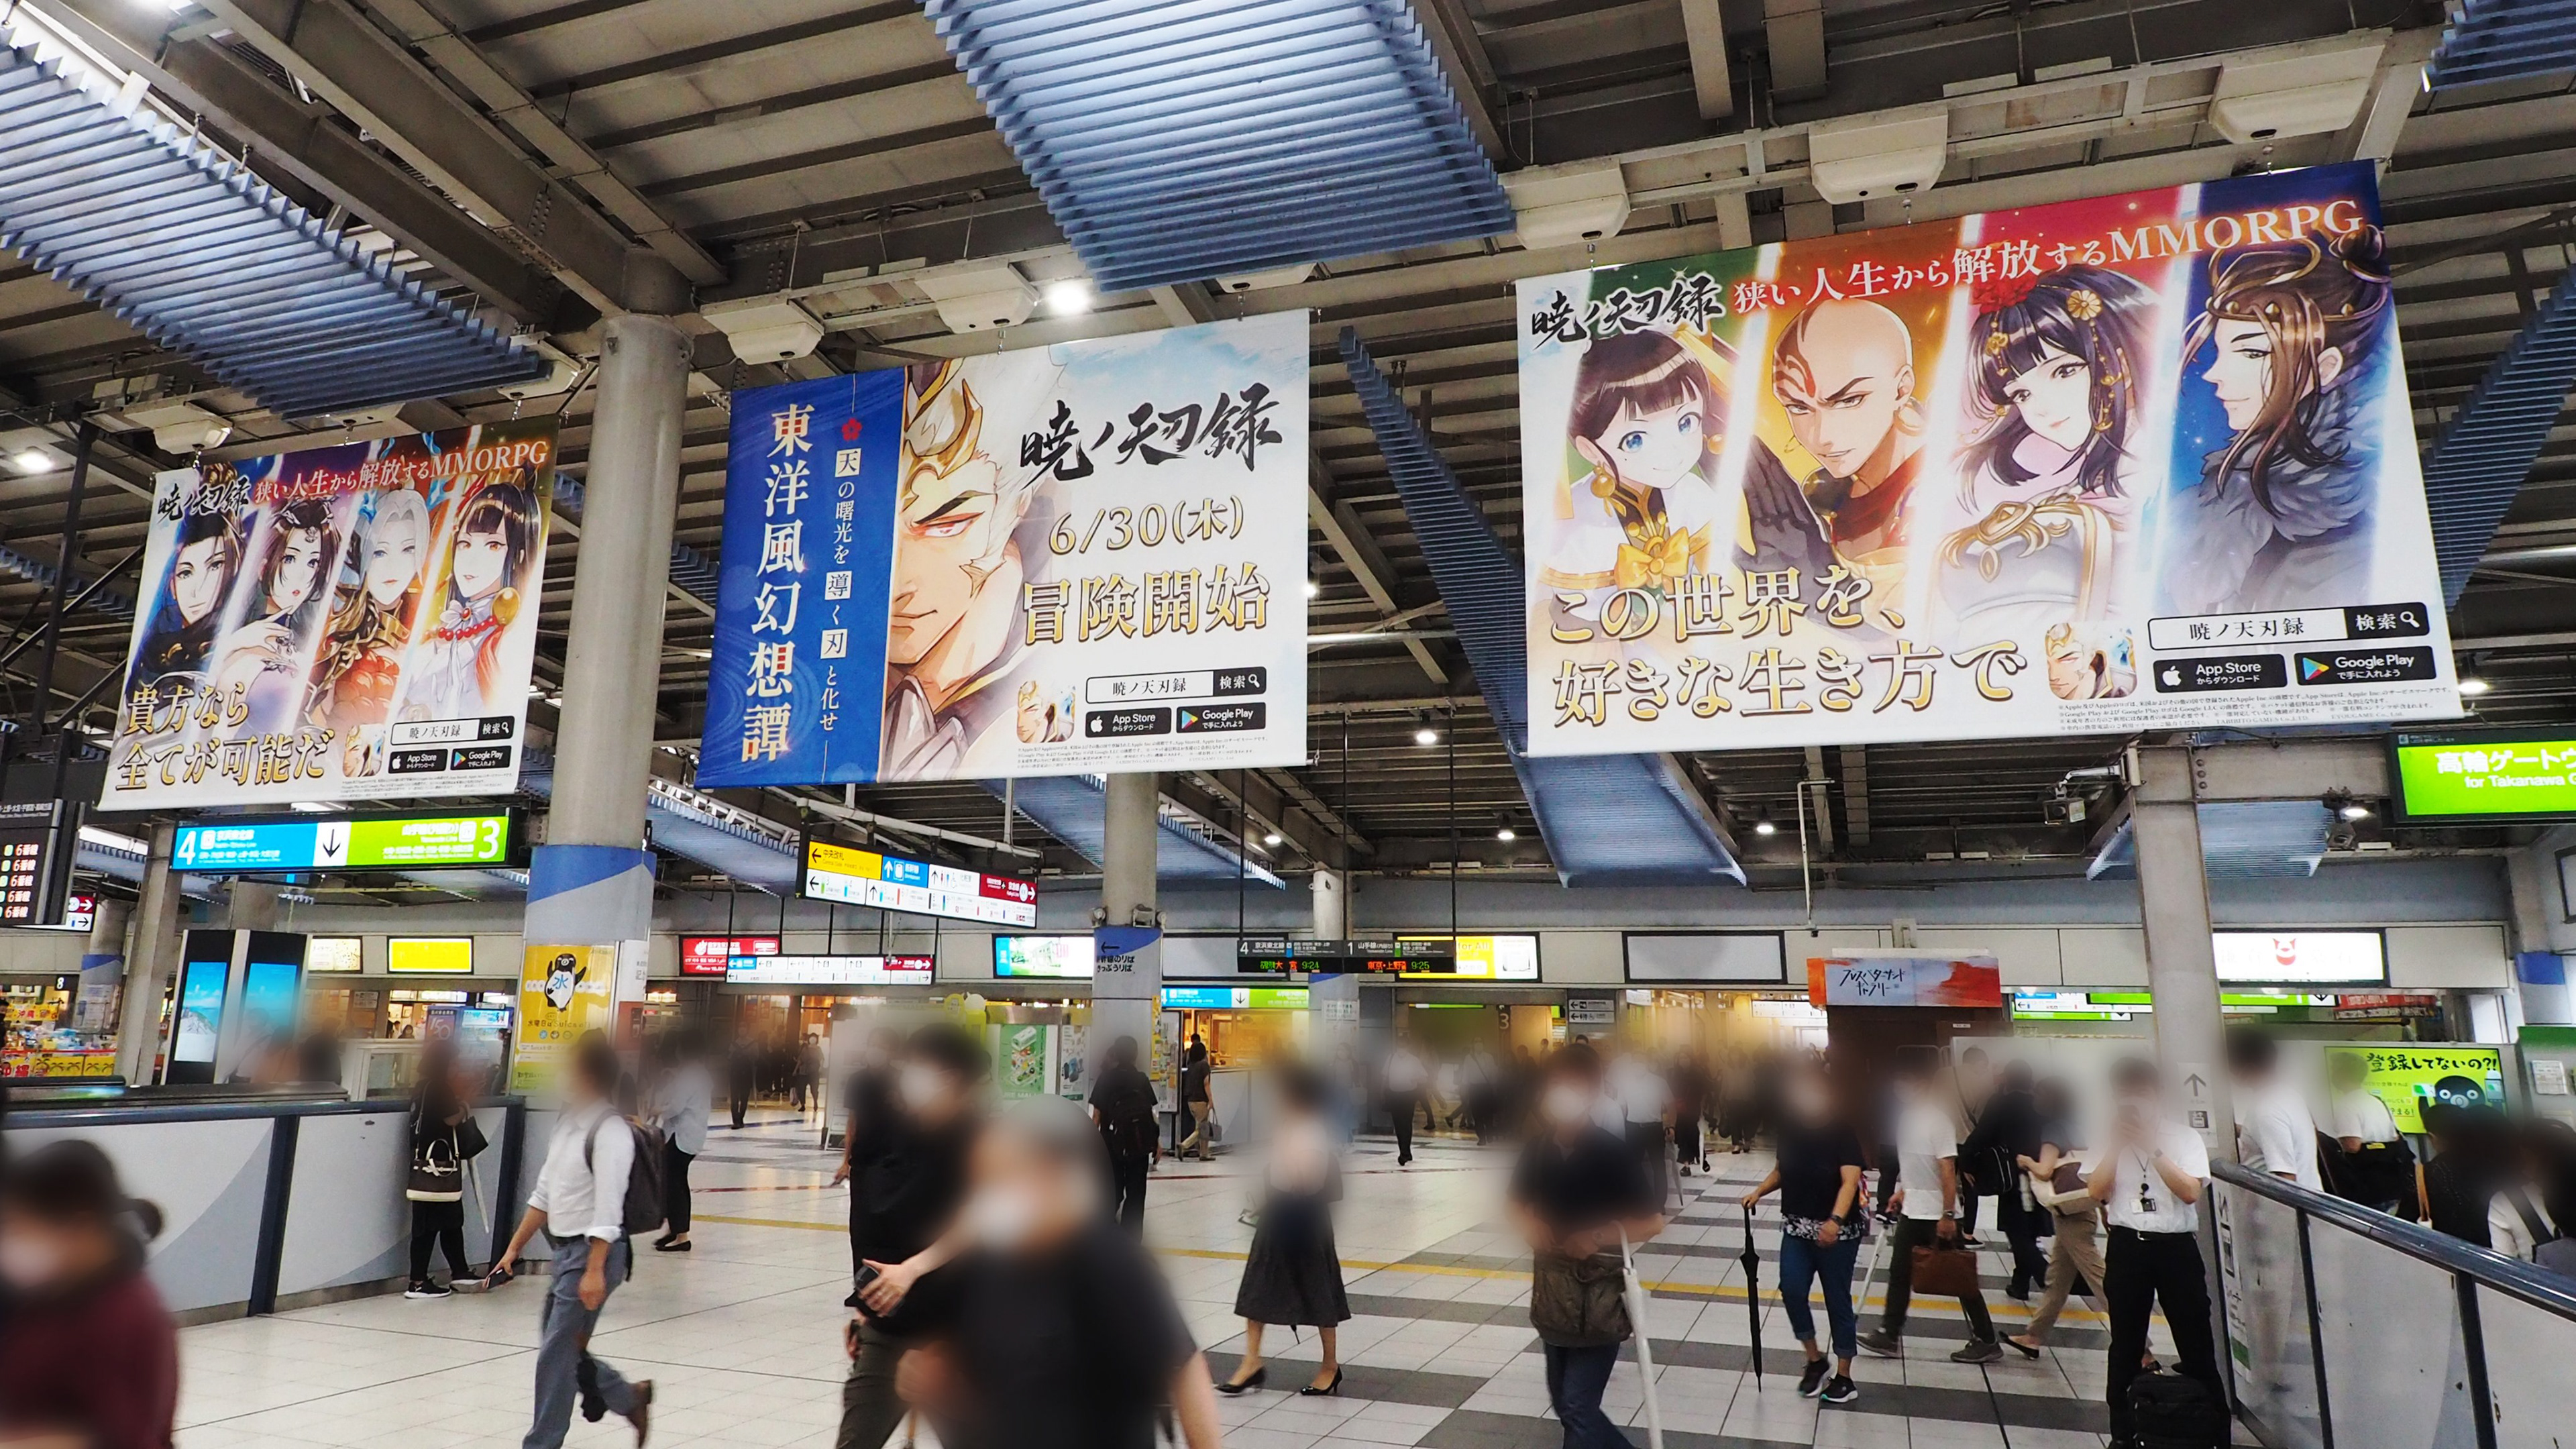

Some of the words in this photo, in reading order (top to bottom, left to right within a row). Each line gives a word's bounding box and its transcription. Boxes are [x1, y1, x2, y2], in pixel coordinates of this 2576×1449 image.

[1732, 199, 2364, 314] 狭い人生から解放するMMORPG
[1530, 275, 1723, 352] 暁ノ天刃録
[1020, 382, 1283, 490] 暁ノ天刃録
[254, 439, 549, 503] 狭い人生から解放するMMORPG
[1049, 495, 1245, 557] 6/30(木)
[741, 402, 816, 763] 東洋風幻想譚
[819, 448, 861, 732] 天の曙光を導く刃と化せ
[1022, 562, 1271, 647] 冒険開始
[1550, 564, 1907, 644] この世界を、
[2189, 617, 2304, 641] 暁ノ天刃録
[2355, 612, 2398, 632] 検索
[2196, 664, 2223, 678] App
[2225, 661, 2262, 674] Store
[2334, 655, 2385, 669] Google
[2386, 654, 2414, 668] Play
[1219, 675, 1246, 690] 検索
[2196, 674, 2261, 686] からダウンロード
[2337, 669, 2401, 680] で手に入れよう
[1112, 678, 1187, 696] 暁ノ天刃録
[1553, 639, 2028, 729] 好きな生き方で
[126, 682, 250, 737] 貴方なら
[1201, 709, 1234, 721] Google
[1235, 708, 1254, 720] Play
[1112, 714, 1132, 727] App
[1132, 713, 1156, 723] Store
[1112, 723, 1154, 732] からダウンロード
[1201, 720, 1244, 730] で手に入れよう
[482, 723, 500, 735] 検索
[115, 729, 335, 792] 全てが可能だ
[407, 754, 421, 763] App
[421, 753, 437, 761] Store
[468, 751, 490, 760] Google
[490, 750, 503, 759] Play
[2464, 775, 2485, 788] for
[2487, 774, 2566, 788] Takanawa
[177, 830, 197, 865] 4
[478, 819, 500, 859] 3
[1240, 941, 1249, 955] 4
[1347, 941, 1353, 956] 1
[1301, 961, 1320, 970] 9:24
[1411, 961, 1430, 970] 9:25
[56, 977, 64, 990] 8
[552, 974, 569, 989] 水
[1499, 1012, 1509, 1030] 3
